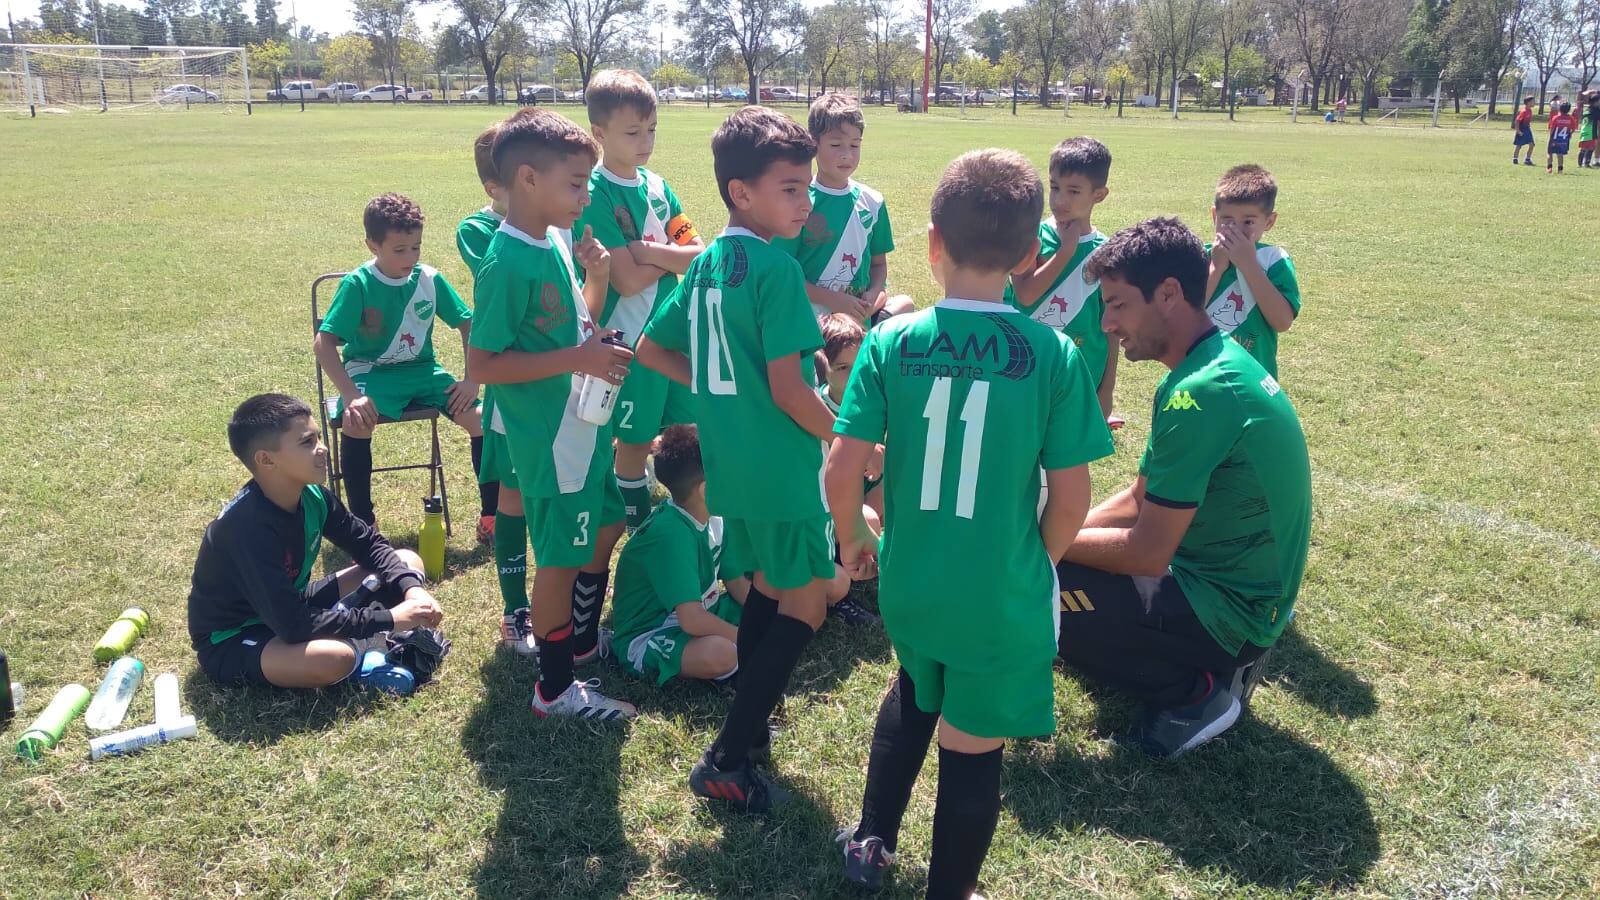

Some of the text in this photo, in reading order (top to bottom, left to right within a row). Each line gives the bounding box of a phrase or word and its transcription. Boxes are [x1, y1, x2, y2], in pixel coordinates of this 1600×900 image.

[1553, 126, 1569, 140] 14
[688, 286, 738, 396] 10
[899, 332, 999, 365] LAM
[899, 360, 984, 381] transporte
[618, 401, 634, 429] 2
[920, 376, 990, 520] 11
[572, 511, 590, 546] 3
